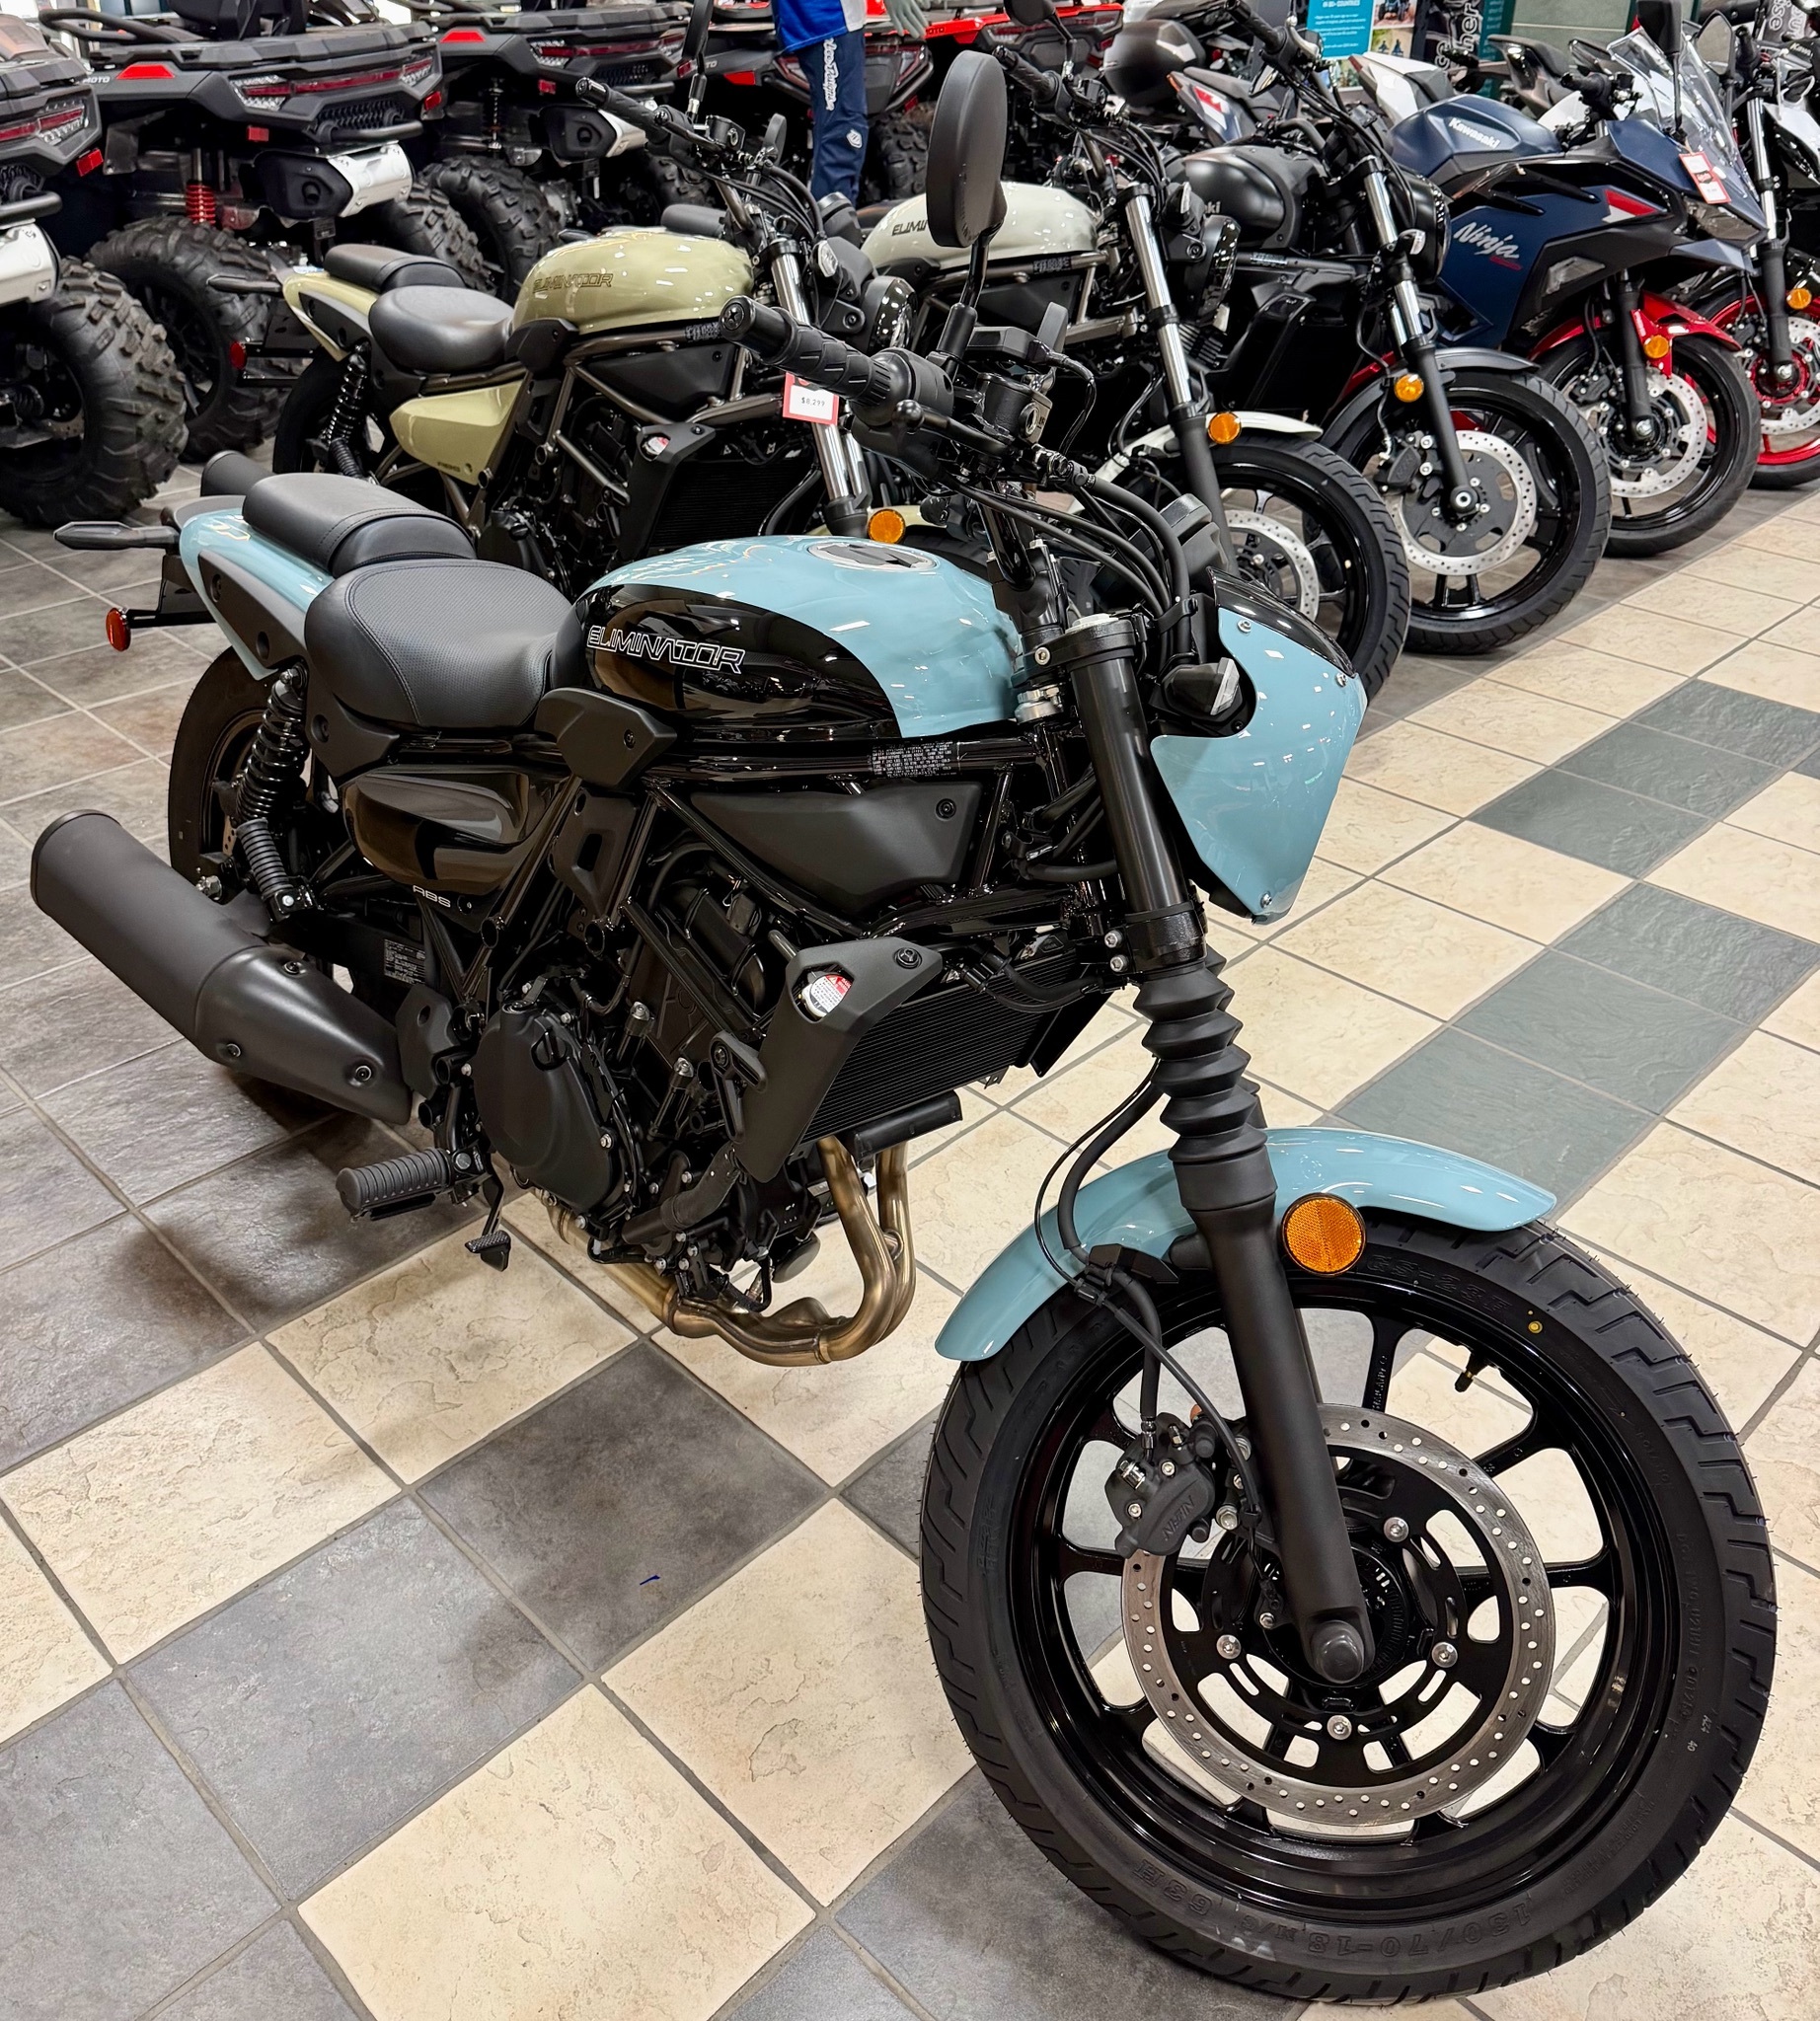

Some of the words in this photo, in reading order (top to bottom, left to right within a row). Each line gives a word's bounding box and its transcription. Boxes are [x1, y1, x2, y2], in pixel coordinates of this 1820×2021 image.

[1452, 2, 1479, 51] her
[1448, 116, 1500, 149] Kawasaki
[1453, 221, 1519, 259] Ninja
[533, 272, 614, 293] ELIMINATOR
[586, 625, 746, 675] ELIMINATOR
[413, 884, 451, 908] ABS
[1133, 1858, 1214, 1916] 63H
[1241, 1914, 1299, 1943] M/C
[1308, 1902, 1532, 1958] 130/70-18
